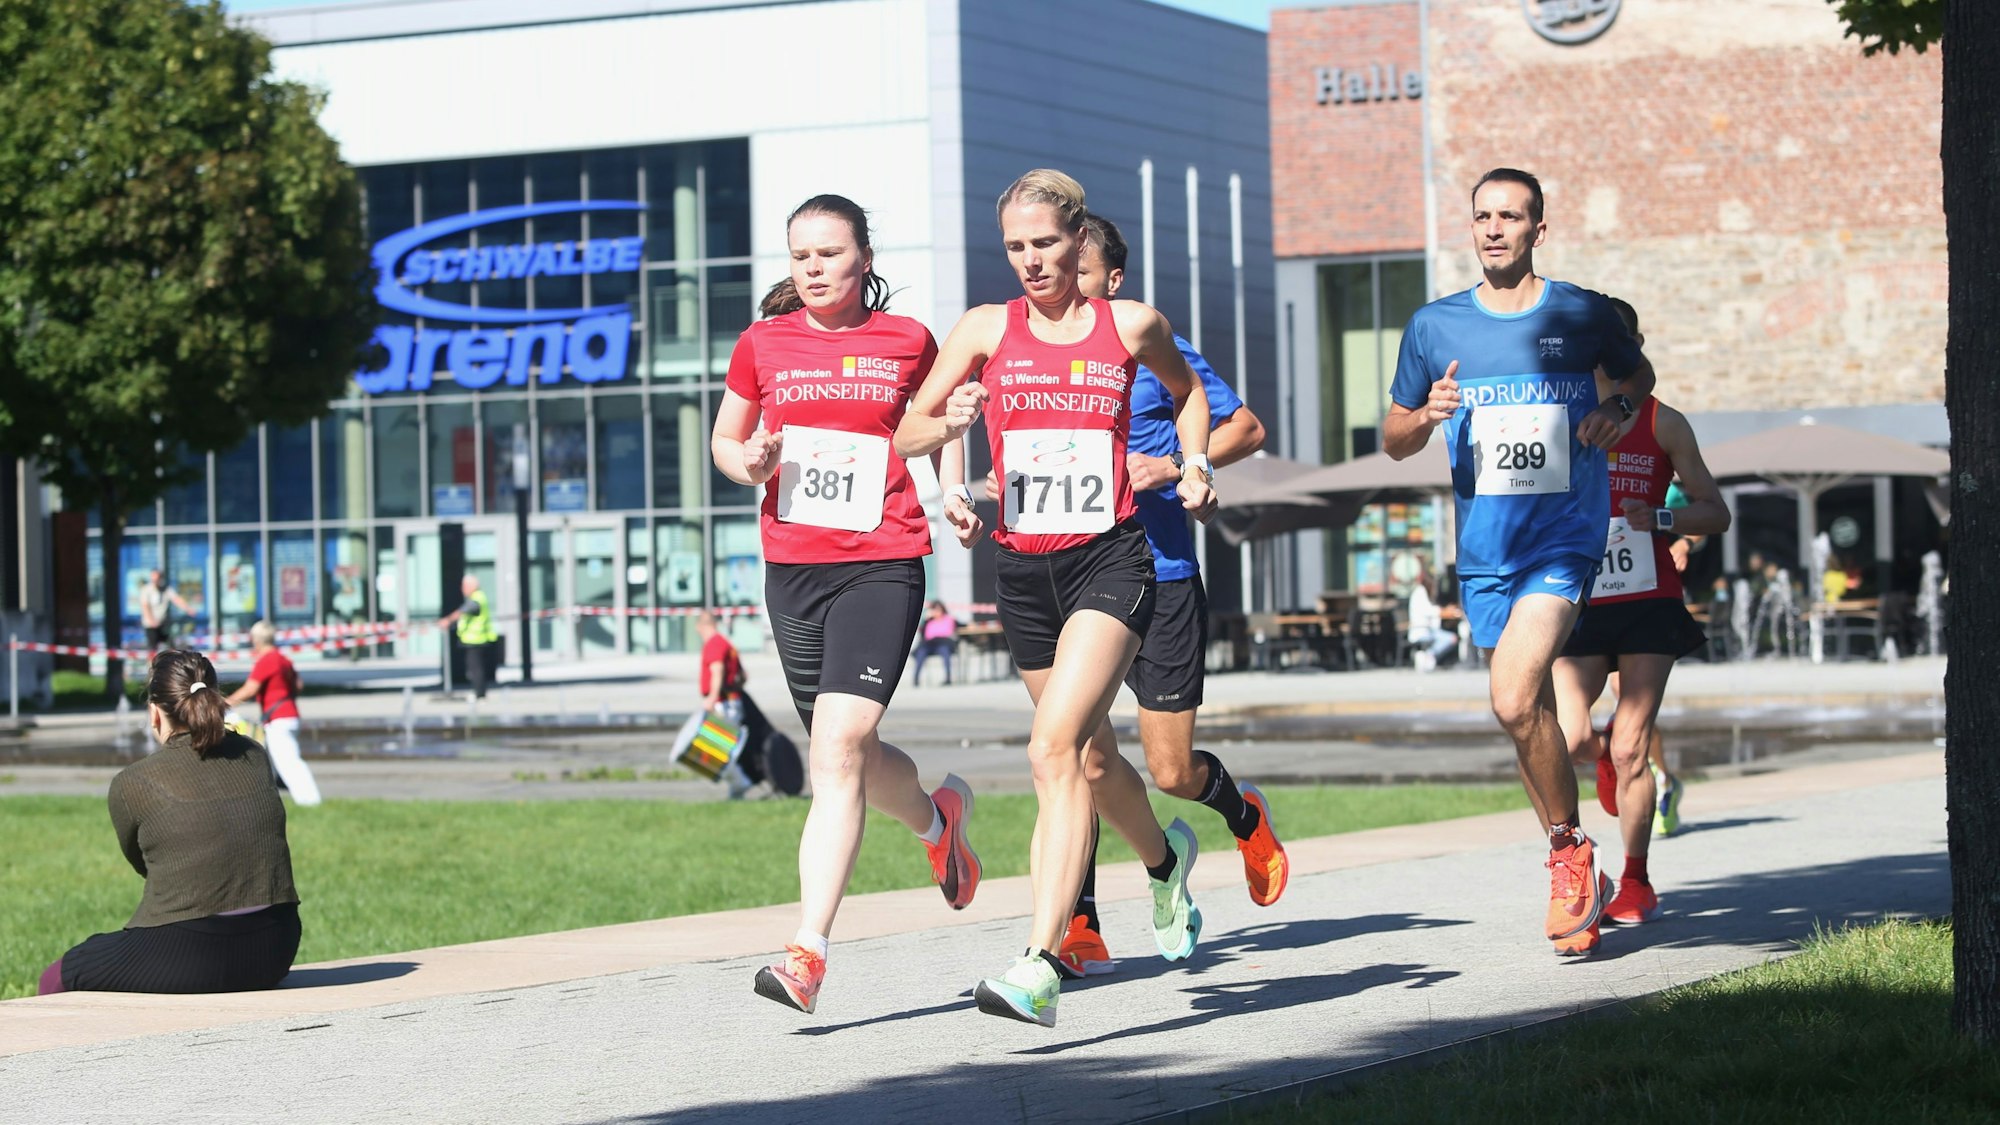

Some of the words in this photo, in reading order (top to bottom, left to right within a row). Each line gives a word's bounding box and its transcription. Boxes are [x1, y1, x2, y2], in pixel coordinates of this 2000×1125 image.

[1316, 63, 1422, 104] Halle
[404, 237, 645, 285] SCHWALBE
[1539, 337, 1563, 345] PFERD
[354, 311, 633, 393] arena
[857, 356, 901, 373] BIGGE
[1086, 360, 1128, 382] BIGGE
[775, 370, 788, 383] SG
[790, 368, 832, 379] Wenden
[857, 368, 898, 382] ENERGIE
[1000, 374, 1013, 387] SG
[1015, 372, 1060, 385] Wenden
[1086, 375, 1127, 394] ENERGIE
[1495, 441, 1546, 470] 289
[1618, 452, 1655, 467] BIGGE
[1618, 463, 1654, 476] ENERGIE
[804, 467, 854, 503] 381
[1508, 478, 1535, 488] Timo
[1011, 474, 1105, 514] 1712
[1601, 581, 1626, 591] Katja
[859, 674, 883, 685] erima
